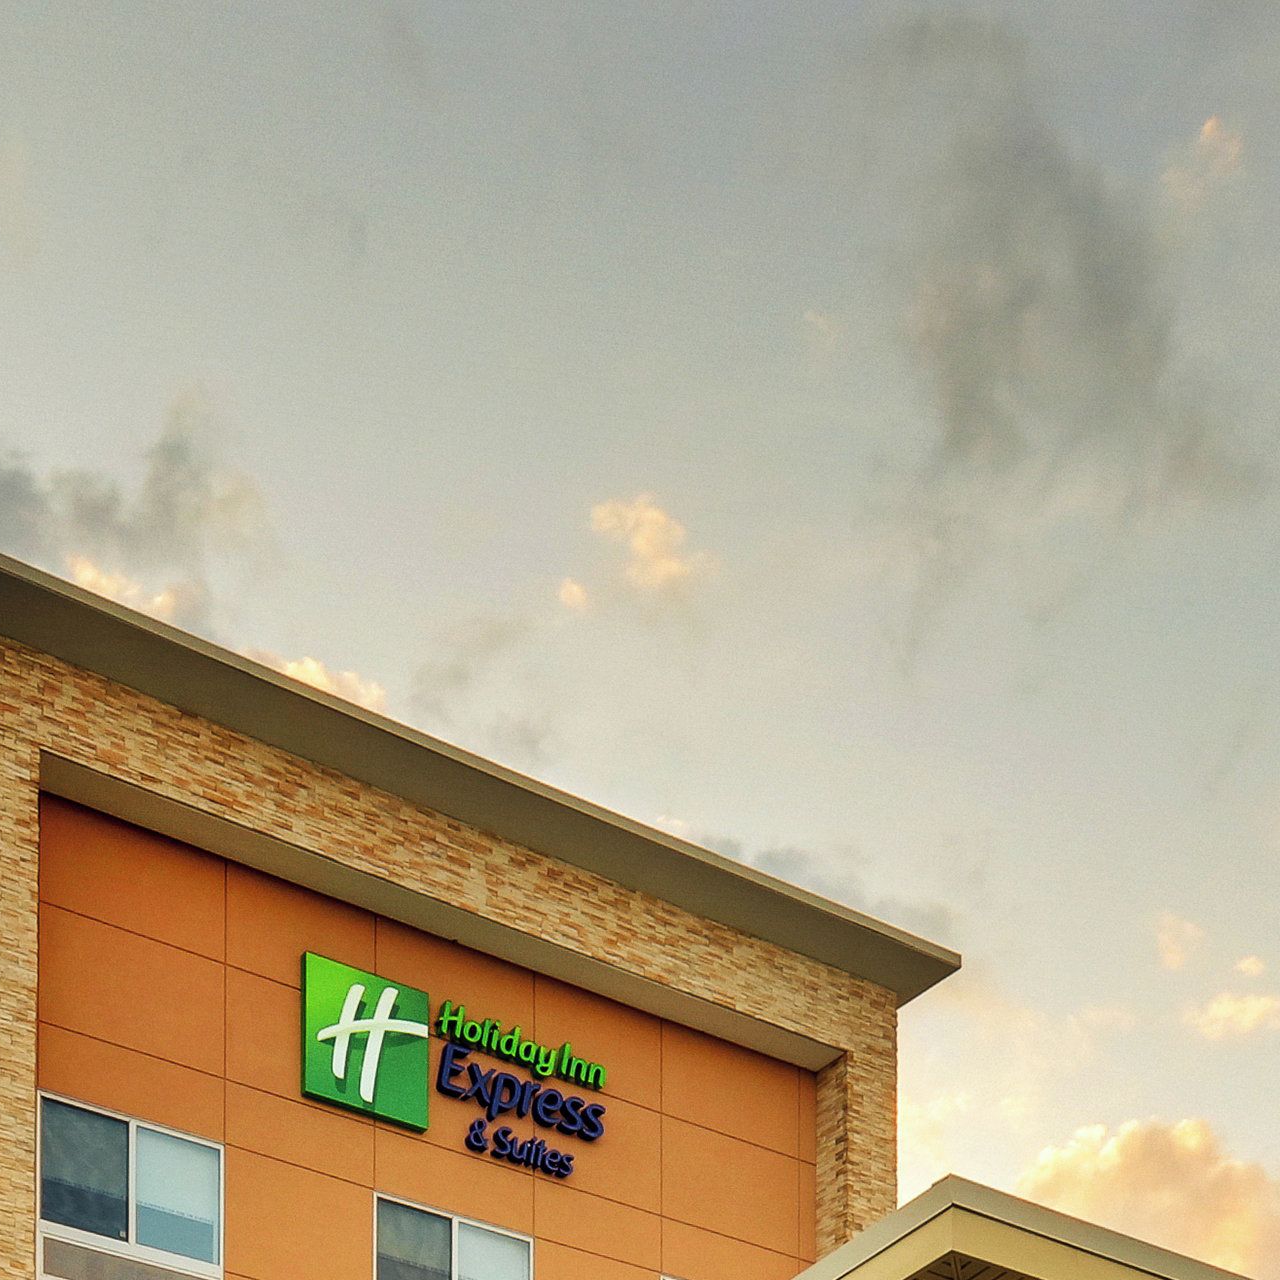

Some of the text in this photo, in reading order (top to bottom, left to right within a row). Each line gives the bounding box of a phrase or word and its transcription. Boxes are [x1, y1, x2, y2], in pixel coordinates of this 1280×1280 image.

[437, 1000, 608, 1089] Holiday Inn
[436, 1043, 606, 1142] Express
[466, 1118, 575, 1178] & Suites
